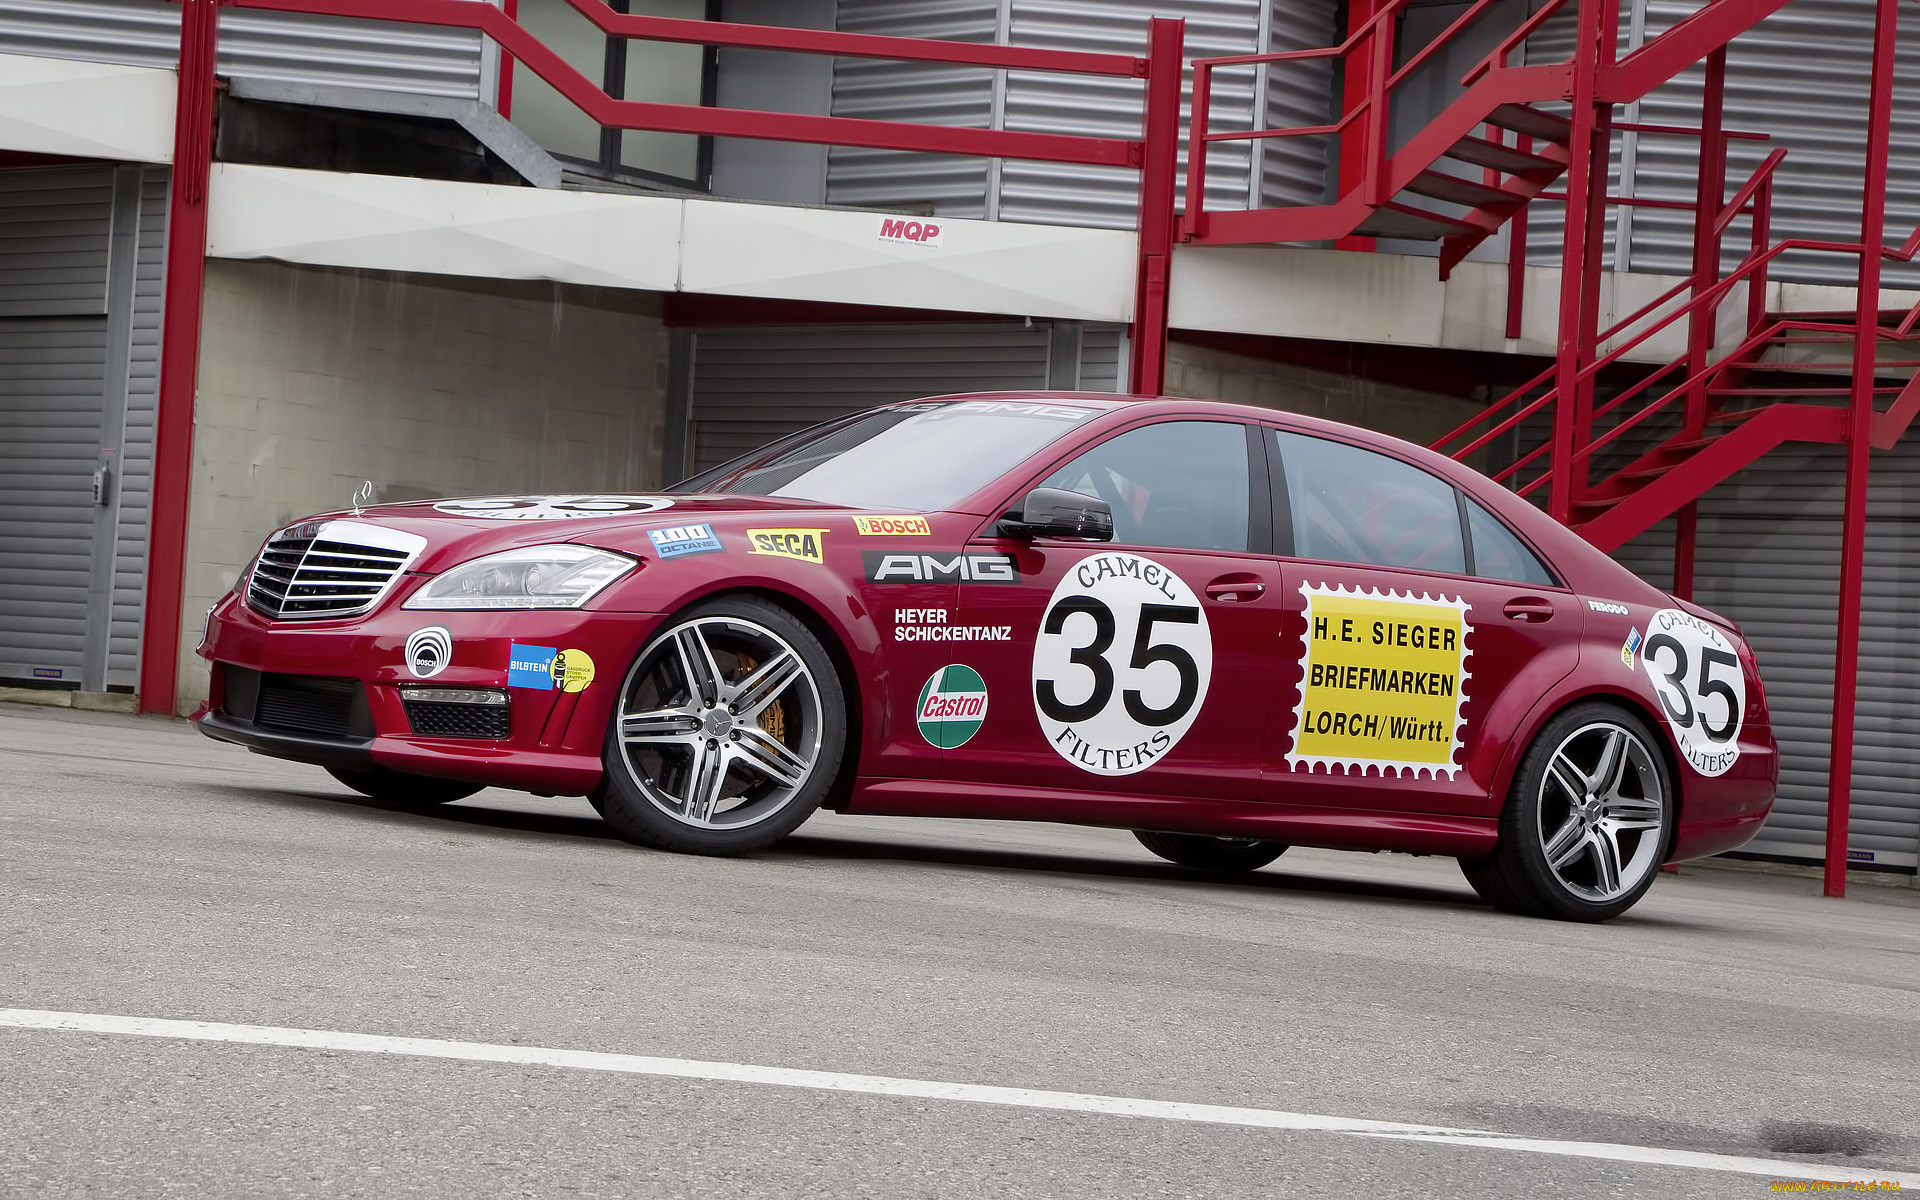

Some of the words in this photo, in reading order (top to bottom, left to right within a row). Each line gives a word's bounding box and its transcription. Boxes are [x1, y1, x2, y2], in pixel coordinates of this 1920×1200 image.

[880, 219, 940, 242] MQP
[943, 404, 1091, 420] AMG
[437, 498, 661, 511] 35
[650, 525, 710, 545] 100
[868, 520, 928, 533] BOSCH
[660, 540, 716, 554] OCTANE
[759, 533, 819, 558] SECA
[874, 555, 1014, 580] AMG
[1077, 556, 1176, 601] CAMEL
[895, 608, 948, 624] HEYER
[1588, 601, 1628, 615] FERODO
[894, 626, 1012, 641] SCHICKENTANZ
[1314, 616, 1362, 642] H.E.
[1372, 621, 1456, 651] SIEGER
[1658, 612, 1722, 647] CAMEL
[416, 658, 437, 667] BOSCH
[510, 661, 549, 673] BILSTEIN
[1036, 595, 1200, 727] 35
[1310, 663, 1454, 697] BRIEFMARKEN
[1644, 633, 1739, 744] 35
[923, 695, 987, 717] Castrol
[1303, 710, 1449, 742] LORCH/Württ.
[1056, 726, 1170, 768] FILTERS
[1680, 734, 1736, 771] FILTERS
